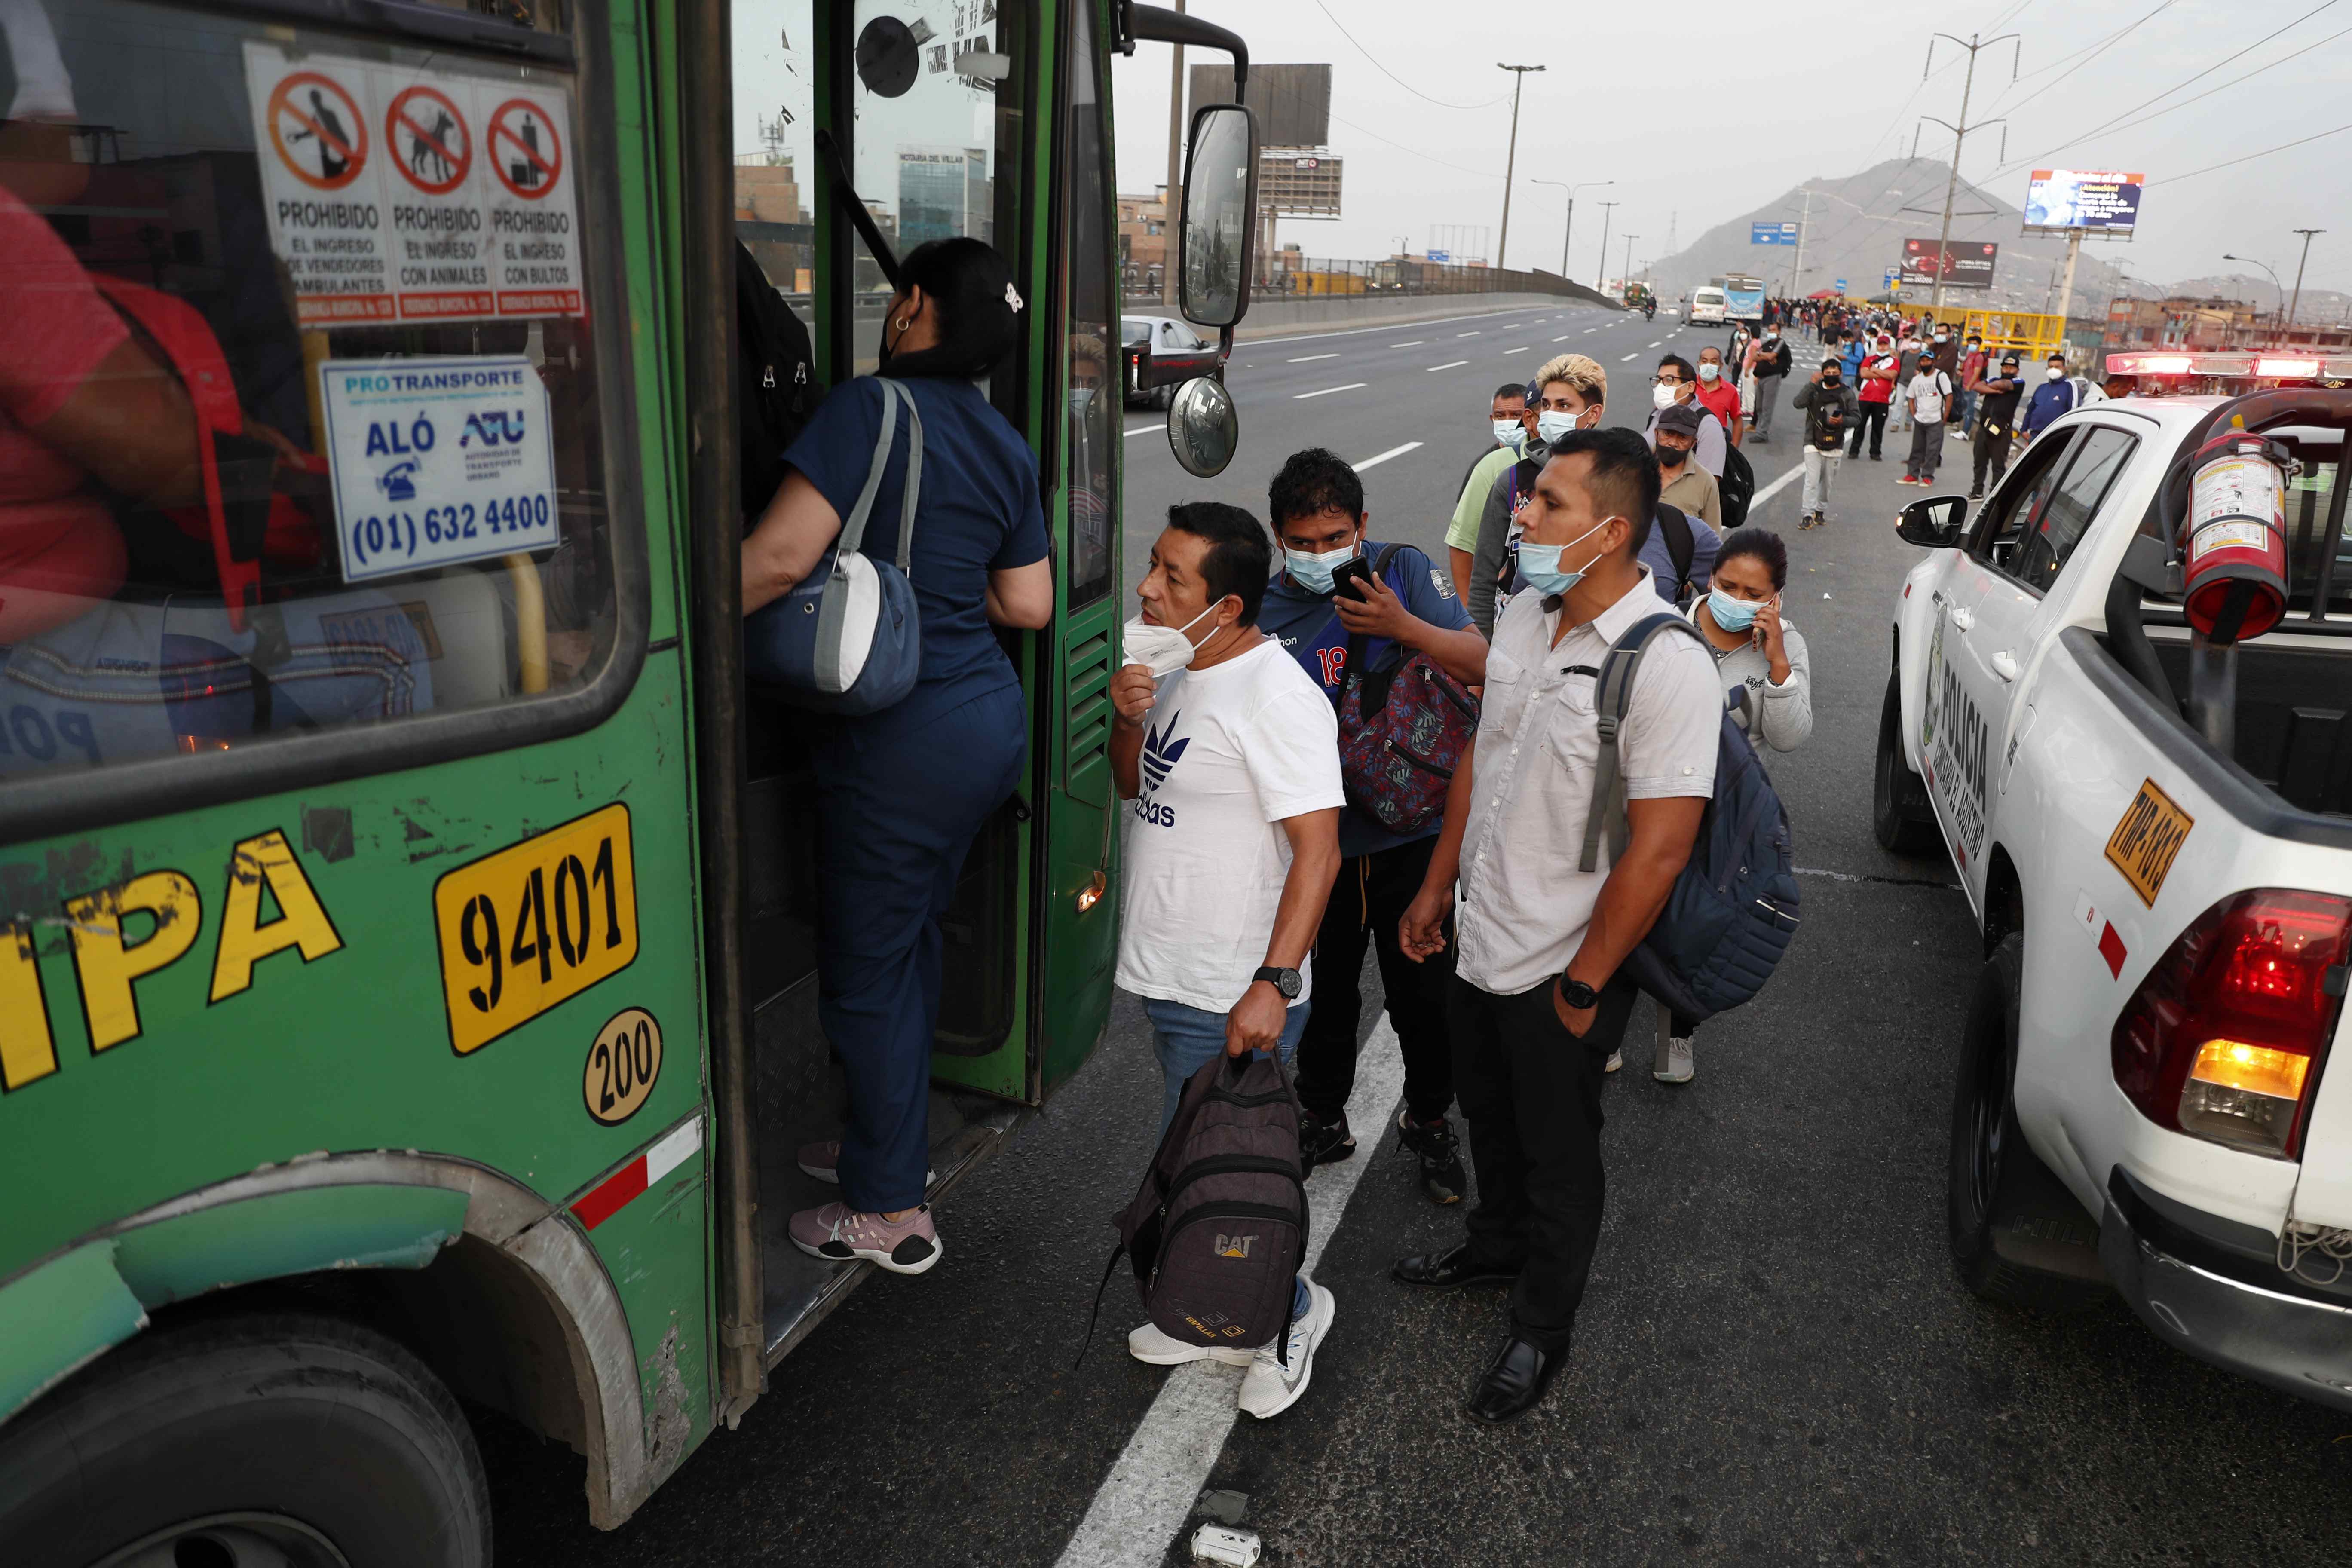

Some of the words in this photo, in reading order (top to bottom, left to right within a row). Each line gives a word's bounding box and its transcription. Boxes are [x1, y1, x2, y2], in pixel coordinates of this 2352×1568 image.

[278, 200, 379, 230] PROHIBIDO
[394, 206, 481, 232] PROHIBIDO
[493, 209, 569, 234] PROHIBIDO
[292, 237, 310, 253] EL
[314, 238, 375, 254] INGRESO
[406, 240, 422, 260] EL
[425, 241, 477, 260] INGRESO
[504, 243, 517, 260] EL
[520, 243, 566, 260] INGRESO
[288, 259, 303, 274] DE
[306, 259, 385, 274] VENDEDORES
[401, 266, 427, 285] CON
[431, 267, 487, 285] ANIMALES
[505, 266, 527, 284] CON
[530, 266, 569, 284] BULTOS
[295, 279, 385, 294] AMBULANTES
[366, 410, 435, 457] ALÓ
[460, 409, 524, 447] ATU
[353, 512, 416, 565] (01)
[424, 502, 477, 544] 632
[484, 493, 549, 534] 4400
[1279, 637, 1297, 646] hon
[1942, 658, 1988, 816] POLICIA
[1955, 787, 1984, 862] AGUSTINO
[2113, 791, 2183, 893] TMP-1813
[460, 836, 622, 1013] 9401
[596, 1020, 652, 1115] 200
